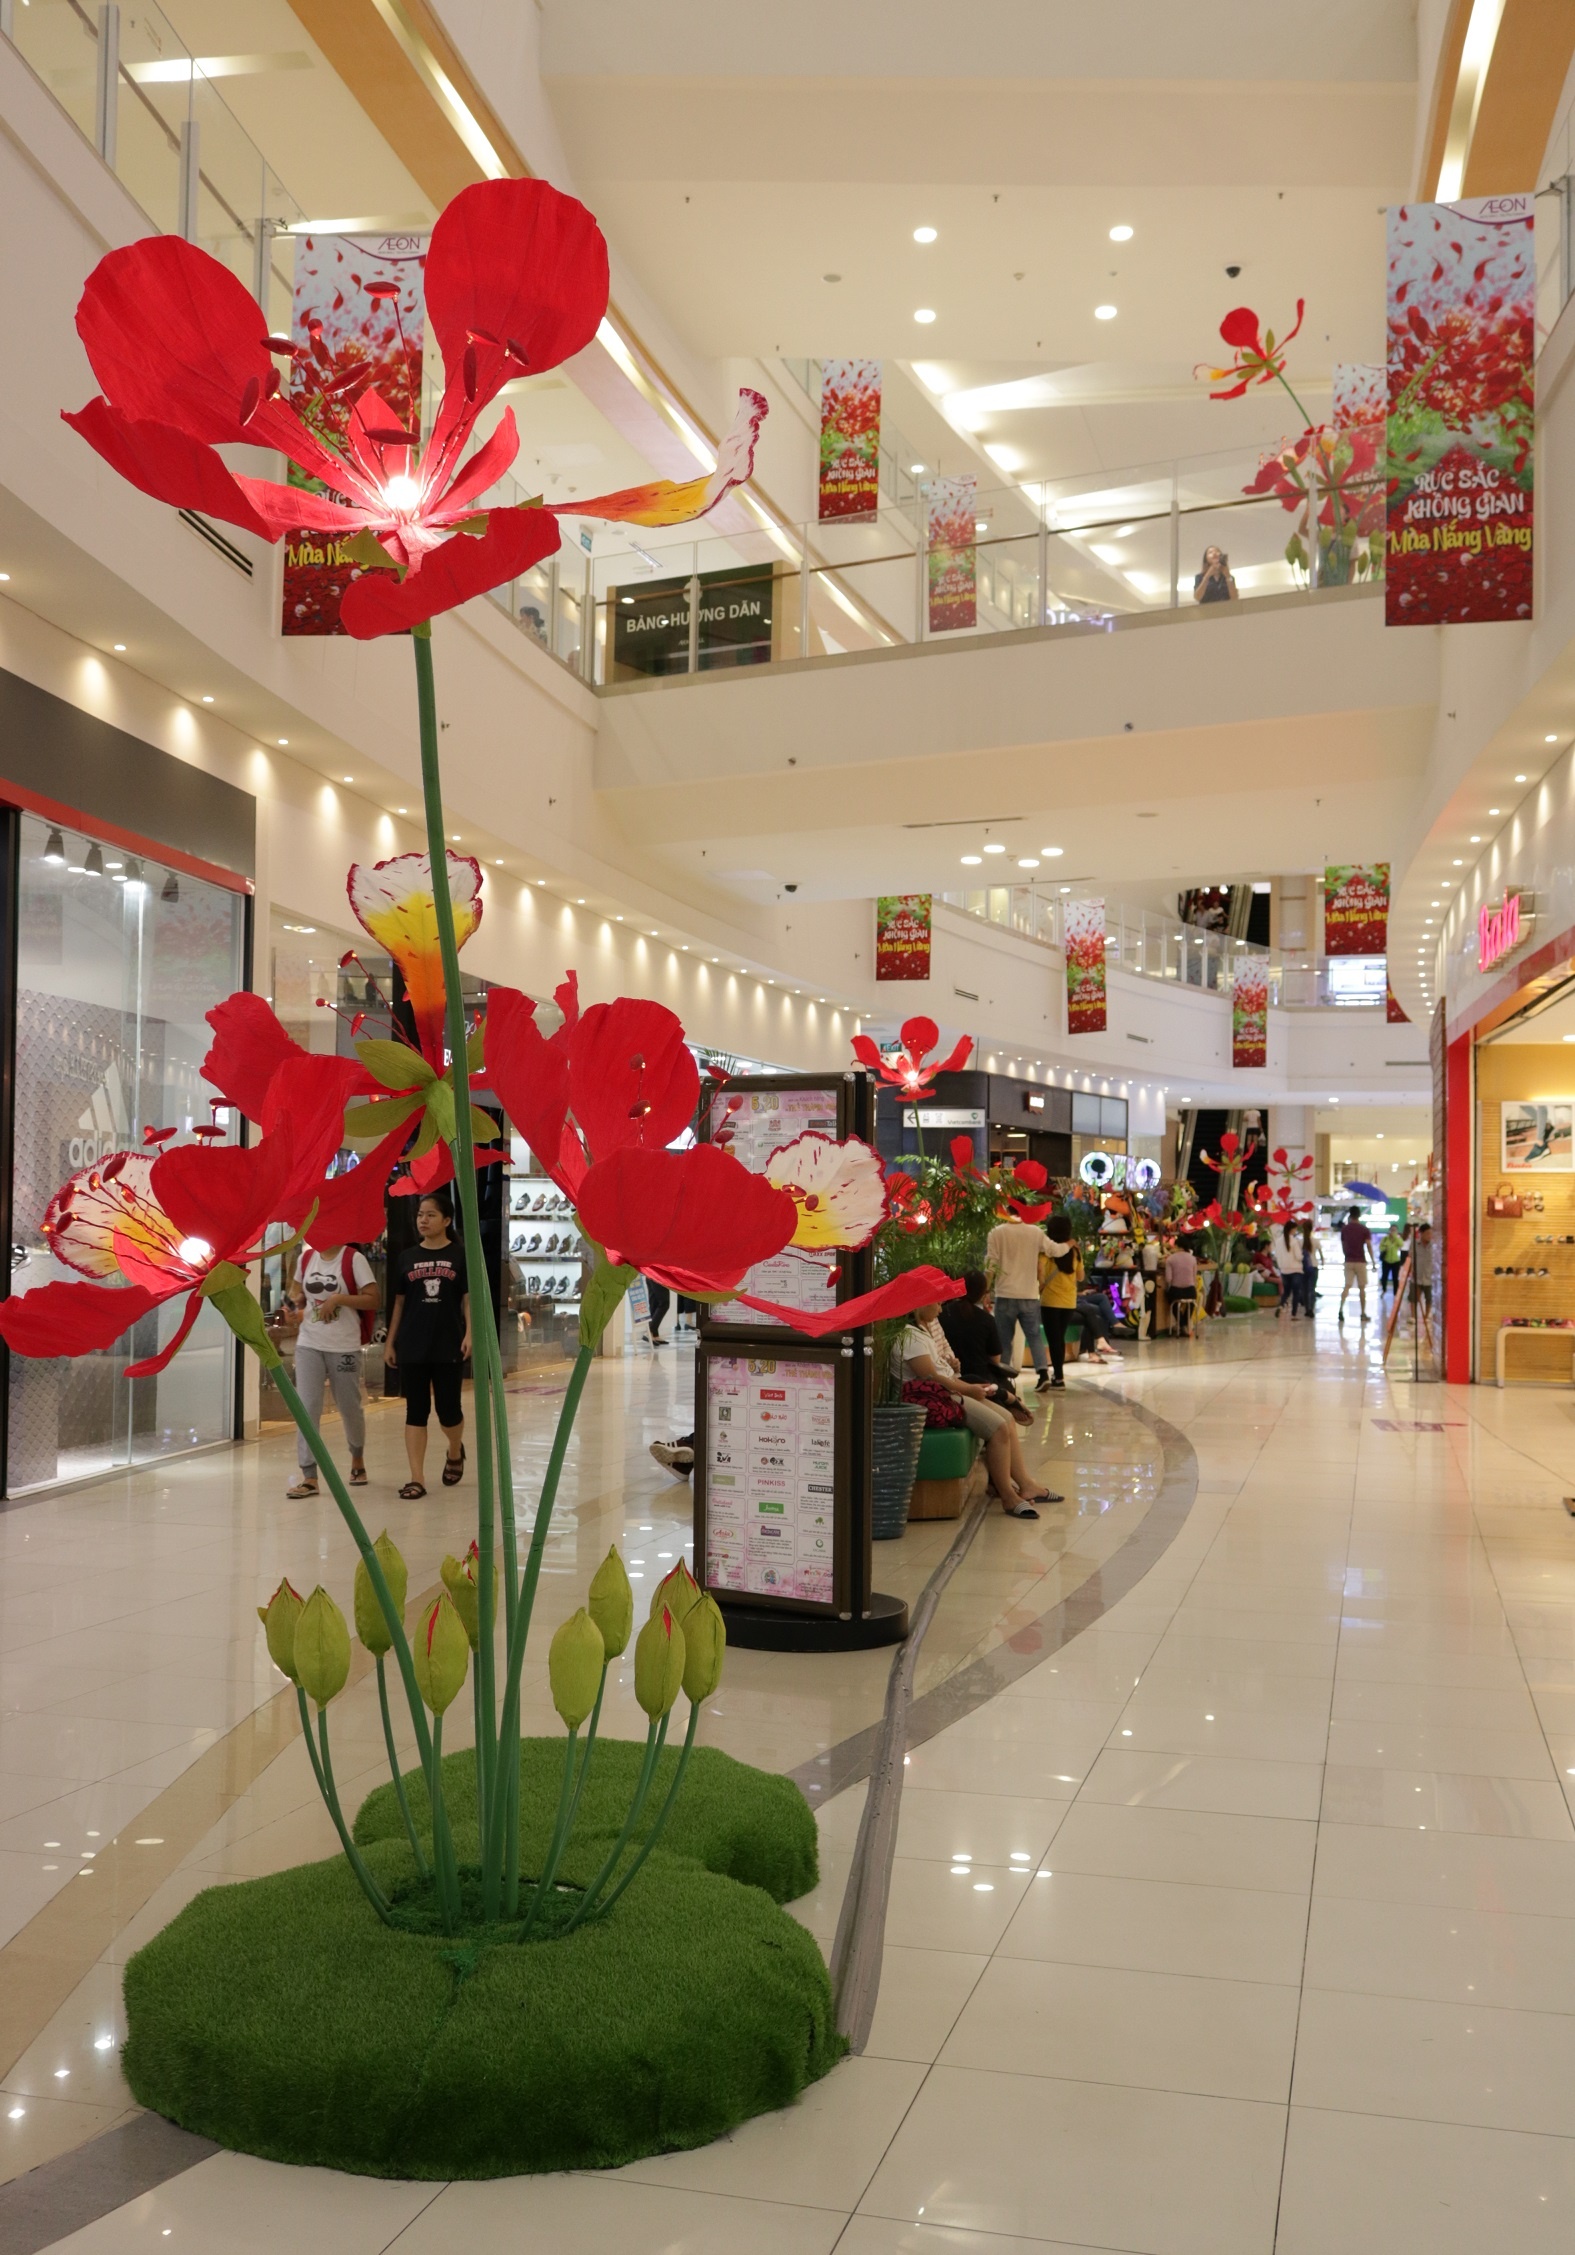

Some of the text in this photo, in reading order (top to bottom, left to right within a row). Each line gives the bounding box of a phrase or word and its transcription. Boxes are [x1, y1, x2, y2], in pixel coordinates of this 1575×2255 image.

[1458, 462, 1500, 489] SẮC
[1407, 491, 1524, 519] KHÔNG GIAN
[1390, 519, 1532, 555] Mùa Nắng Vàng
[288, 541, 324, 567] Mùa
[408, 1267, 456, 1281] BULLDOG
[413, 1261, 435, 1269] FEAR
[757, 1479, 786, 1487] PINKISS
